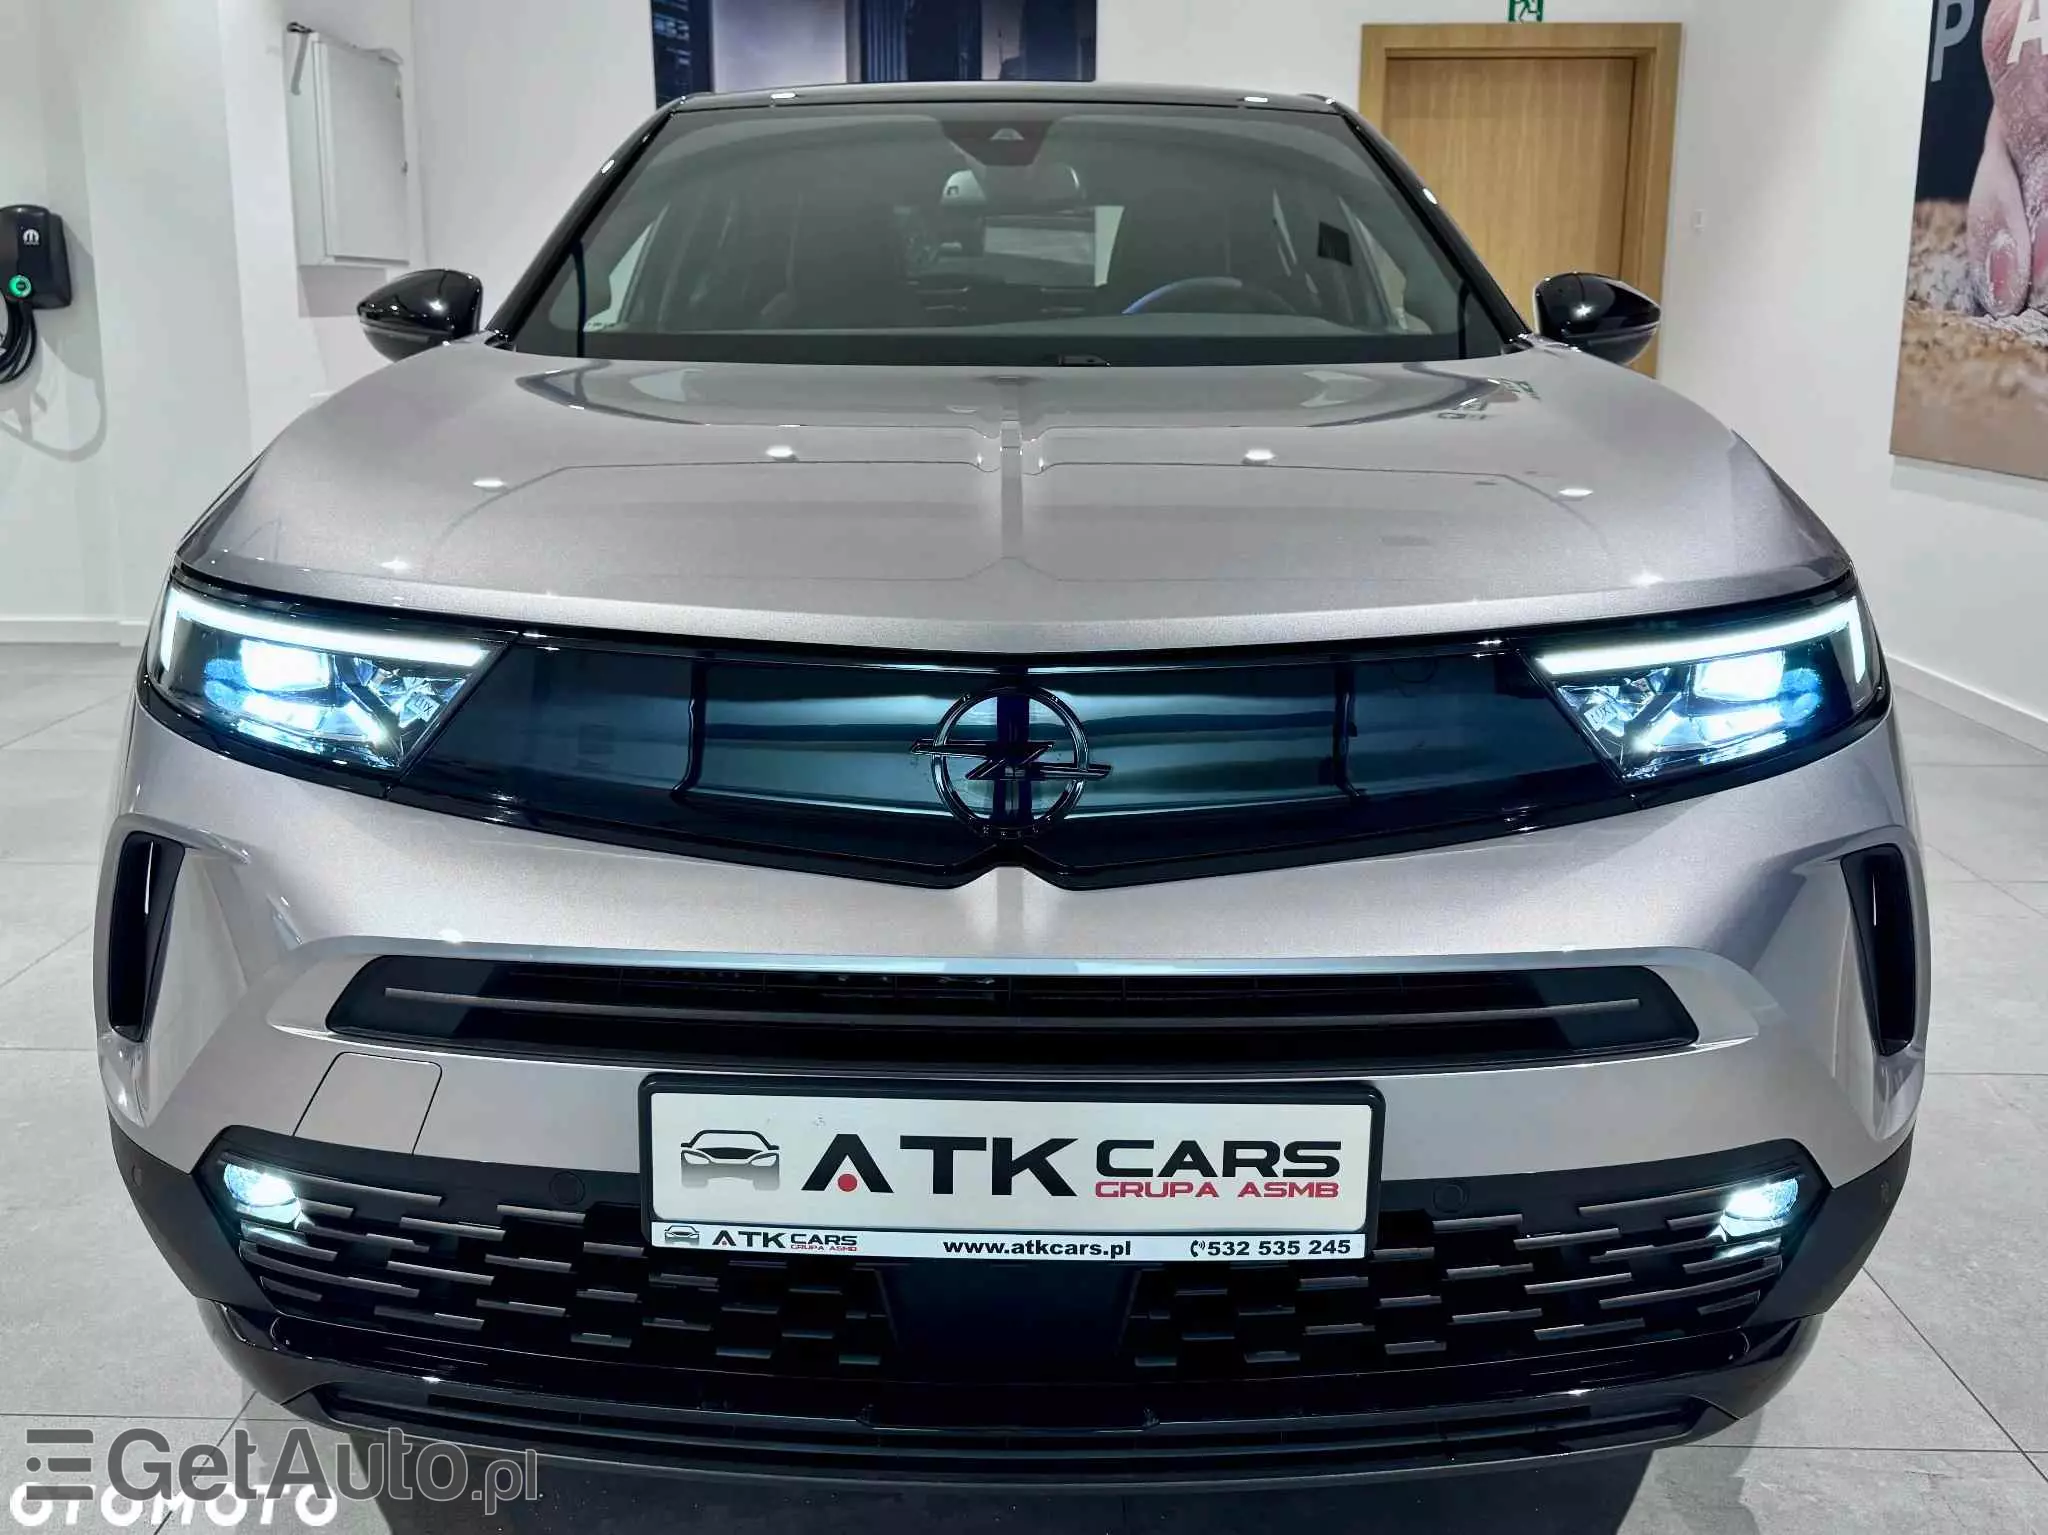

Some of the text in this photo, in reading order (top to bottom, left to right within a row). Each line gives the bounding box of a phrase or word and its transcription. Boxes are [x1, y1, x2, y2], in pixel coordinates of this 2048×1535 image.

[801, 1134, 1342, 1197] ATK CARS
[1095, 1181, 1339, 1198] GRUPA ASMB
[712, 1230, 858, 1249] ATK CARS
[943, 1239, 1131, 1259] www.atkcars.pl
[1207, 1239, 1351, 1256] 532 535 245
